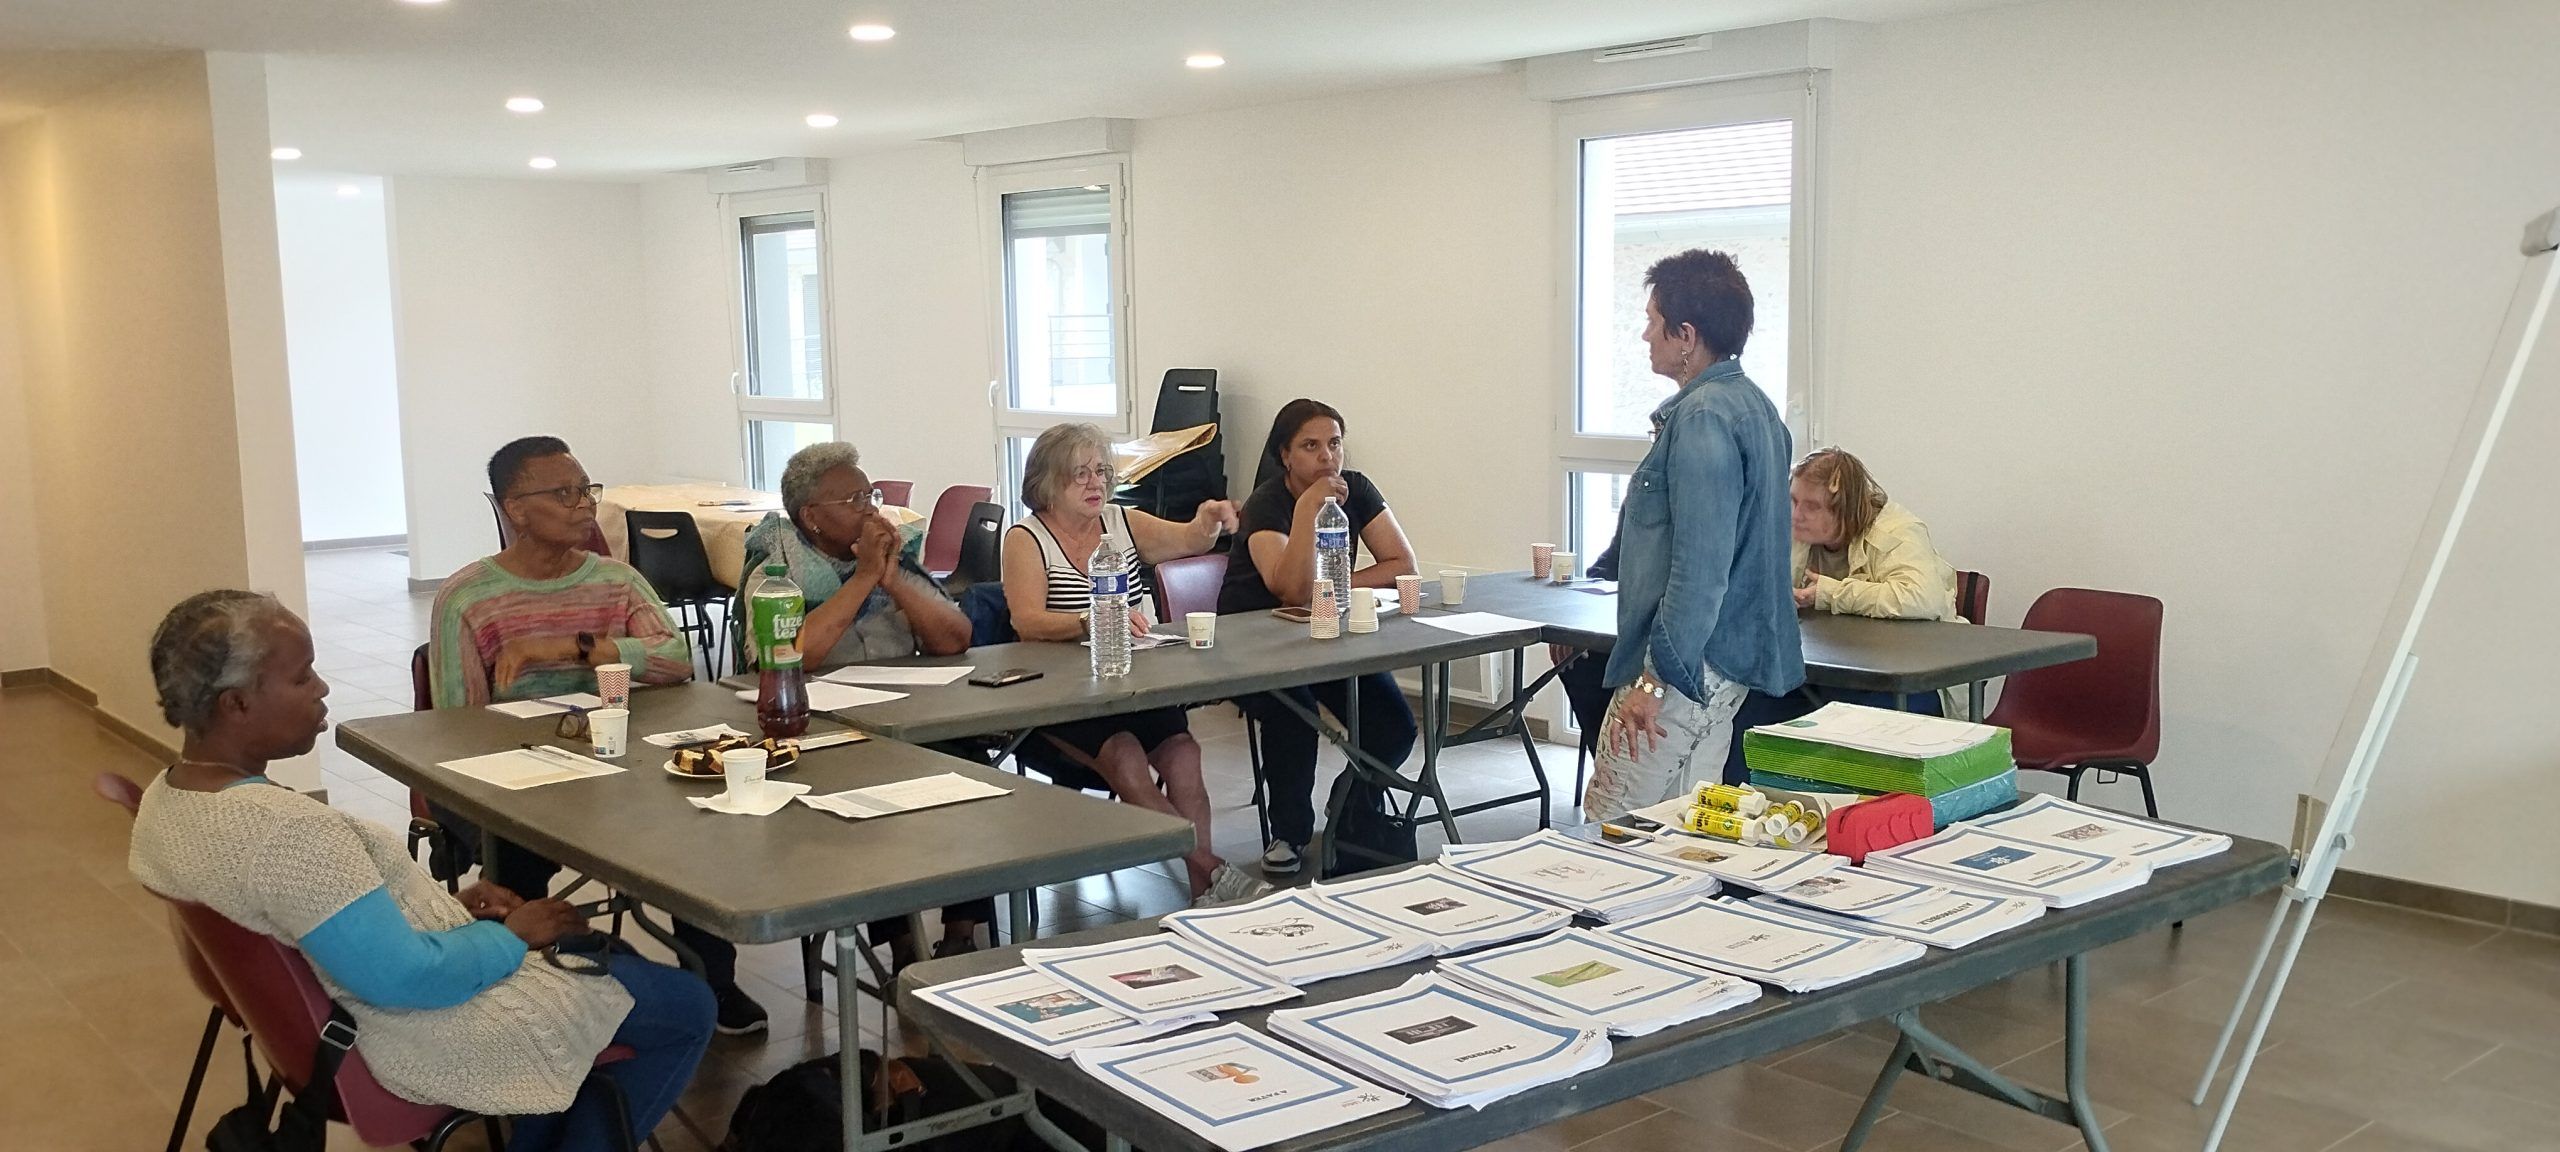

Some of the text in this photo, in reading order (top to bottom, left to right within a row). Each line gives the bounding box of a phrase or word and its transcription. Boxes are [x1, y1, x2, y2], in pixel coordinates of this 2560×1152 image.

[773, 614, 802, 629] fuze
[774, 627, 797, 640] tea
[1454, 1044, 1517, 1063] Tribunal
